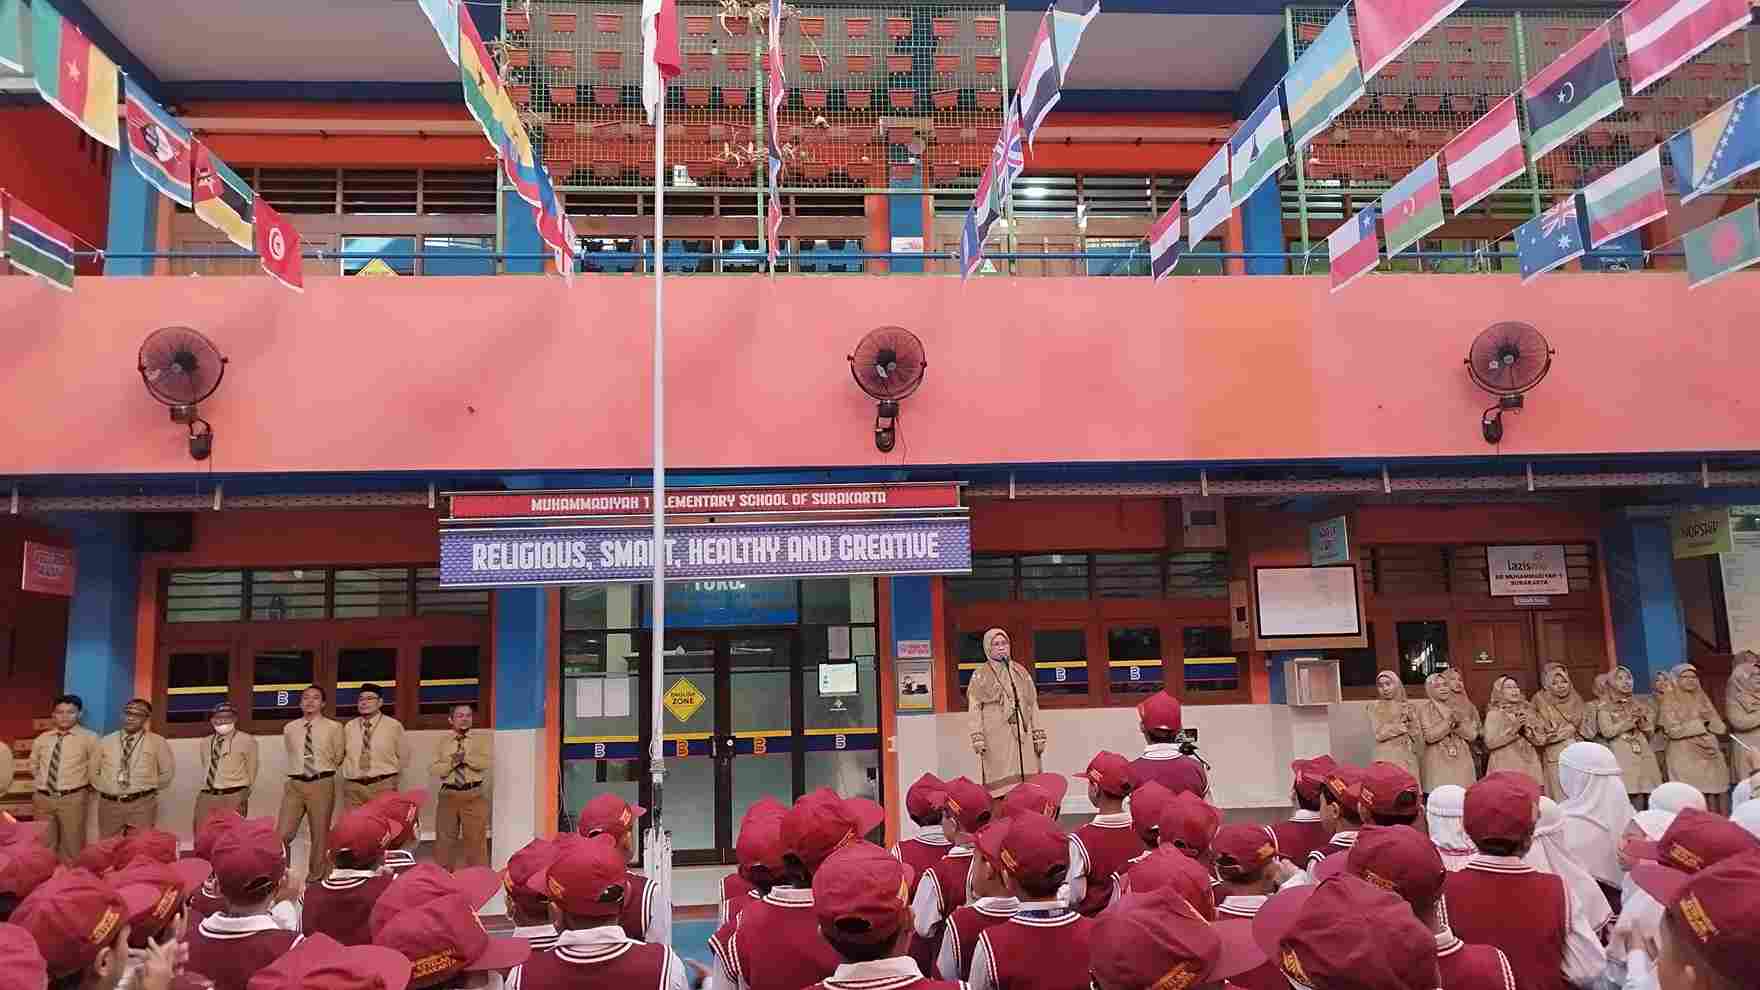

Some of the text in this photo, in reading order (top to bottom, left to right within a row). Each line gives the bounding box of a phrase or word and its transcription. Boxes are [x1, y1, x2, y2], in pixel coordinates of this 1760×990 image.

[531, 496, 639, 511] MUHAMMADIYAH
[739, 493, 788, 507] SCHOOL
[792, 493, 808, 506] OF
[812, 491, 887, 505] SURAKARTA
[472, 541, 593, 571] RELIGIOUS,
[688, 536, 780, 565] HEALTHY
[787, 534, 831, 562] AND
[839, 532, 939, 561] CREATIVE
[672, 697, 695, 706] ZONE
